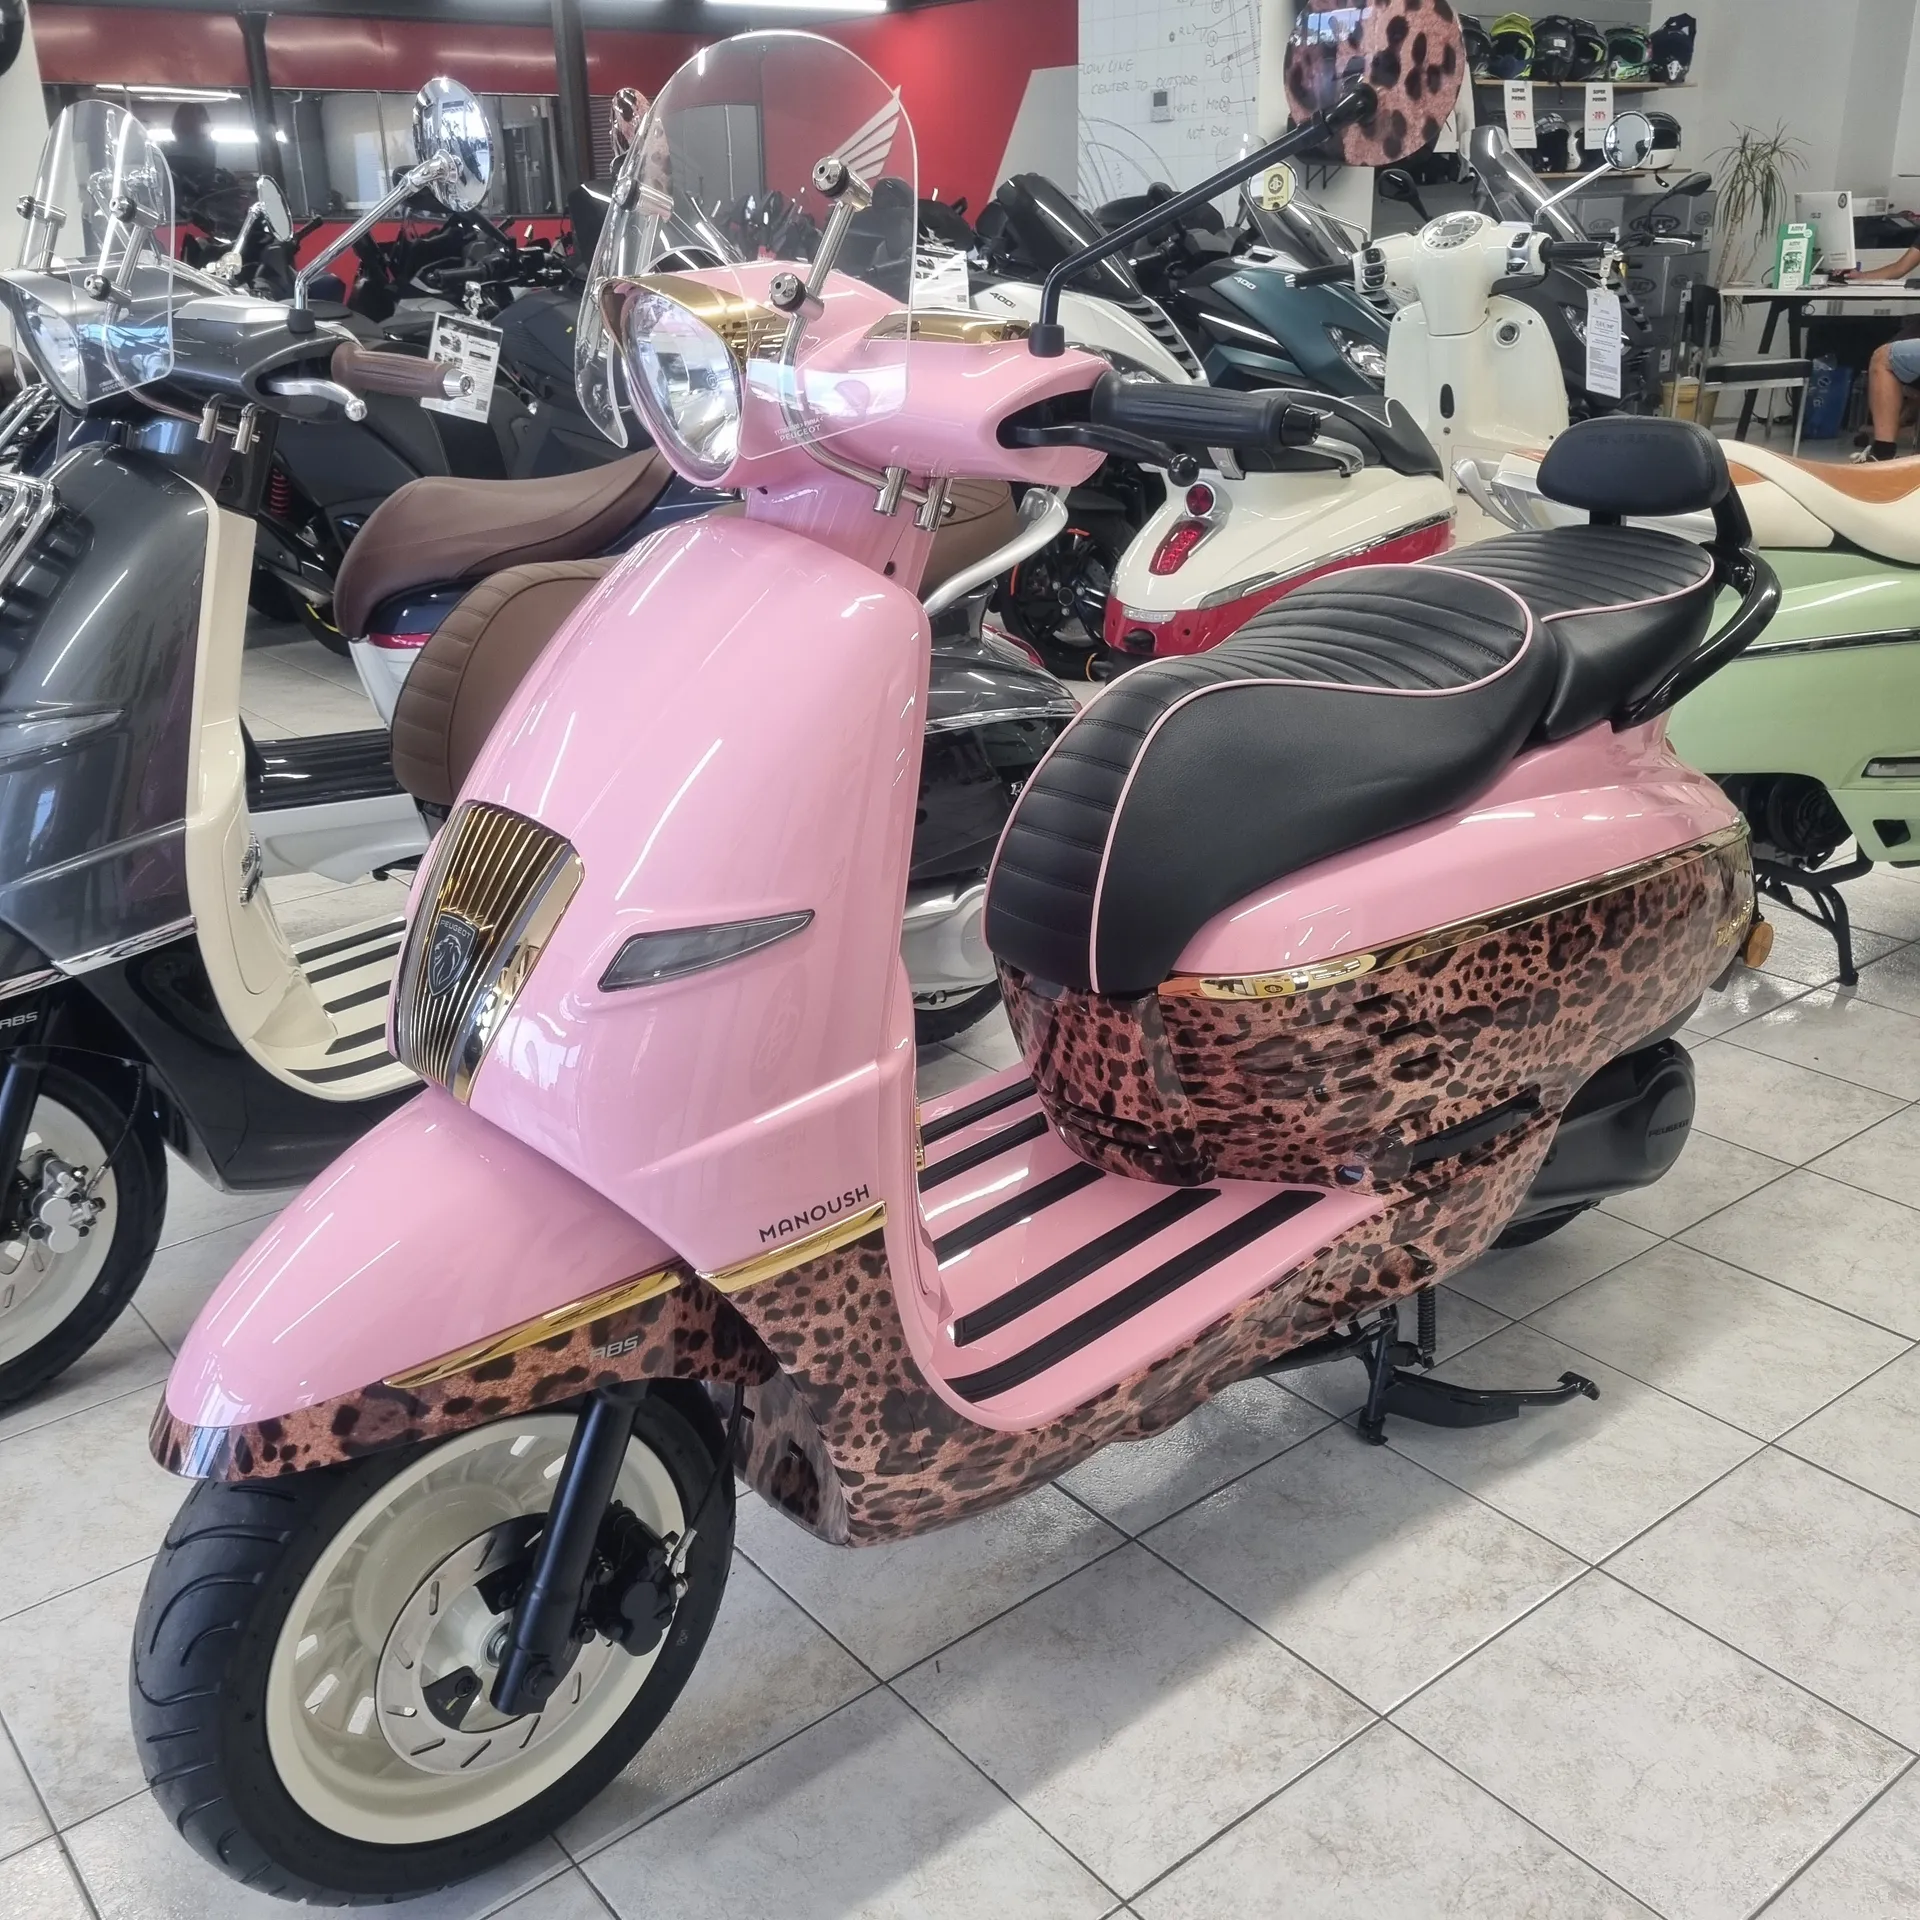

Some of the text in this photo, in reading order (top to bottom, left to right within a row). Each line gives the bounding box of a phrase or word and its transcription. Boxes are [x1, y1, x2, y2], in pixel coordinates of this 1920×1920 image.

[440, 920, 472, 939] PEUGEOT
[0, 1011, 38, 1030] ABS
[758, 1184, 870, 1243] MANOUSH
[591, 1335, 639, 1360] ABS
